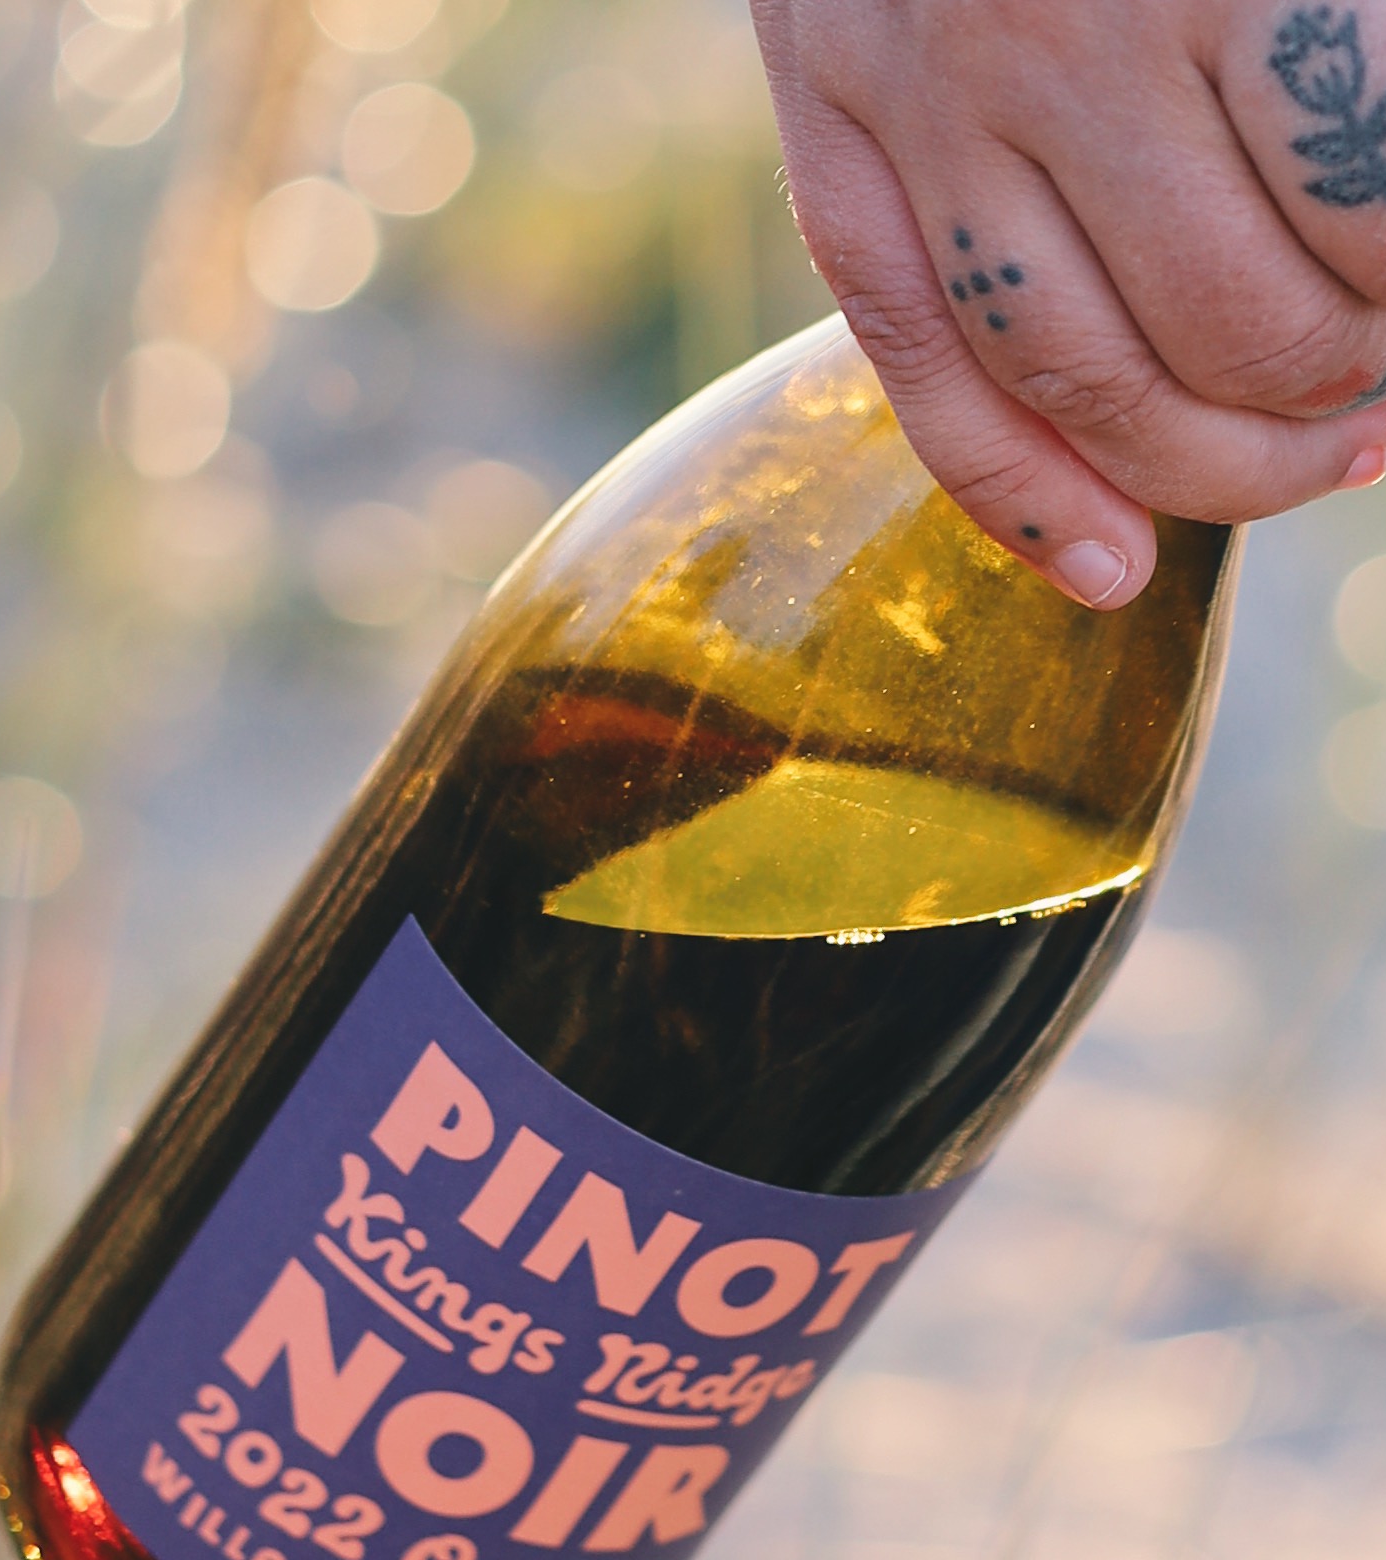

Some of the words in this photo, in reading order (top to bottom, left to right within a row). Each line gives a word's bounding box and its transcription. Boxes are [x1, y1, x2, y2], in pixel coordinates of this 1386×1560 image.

[324, 1152, 564, 1374] Kings
[583, 1333, 816, 1427] Ridge
[371, 1041, 916, 1336] PINOT
[222, 1257, 730, 1550] NOIR
